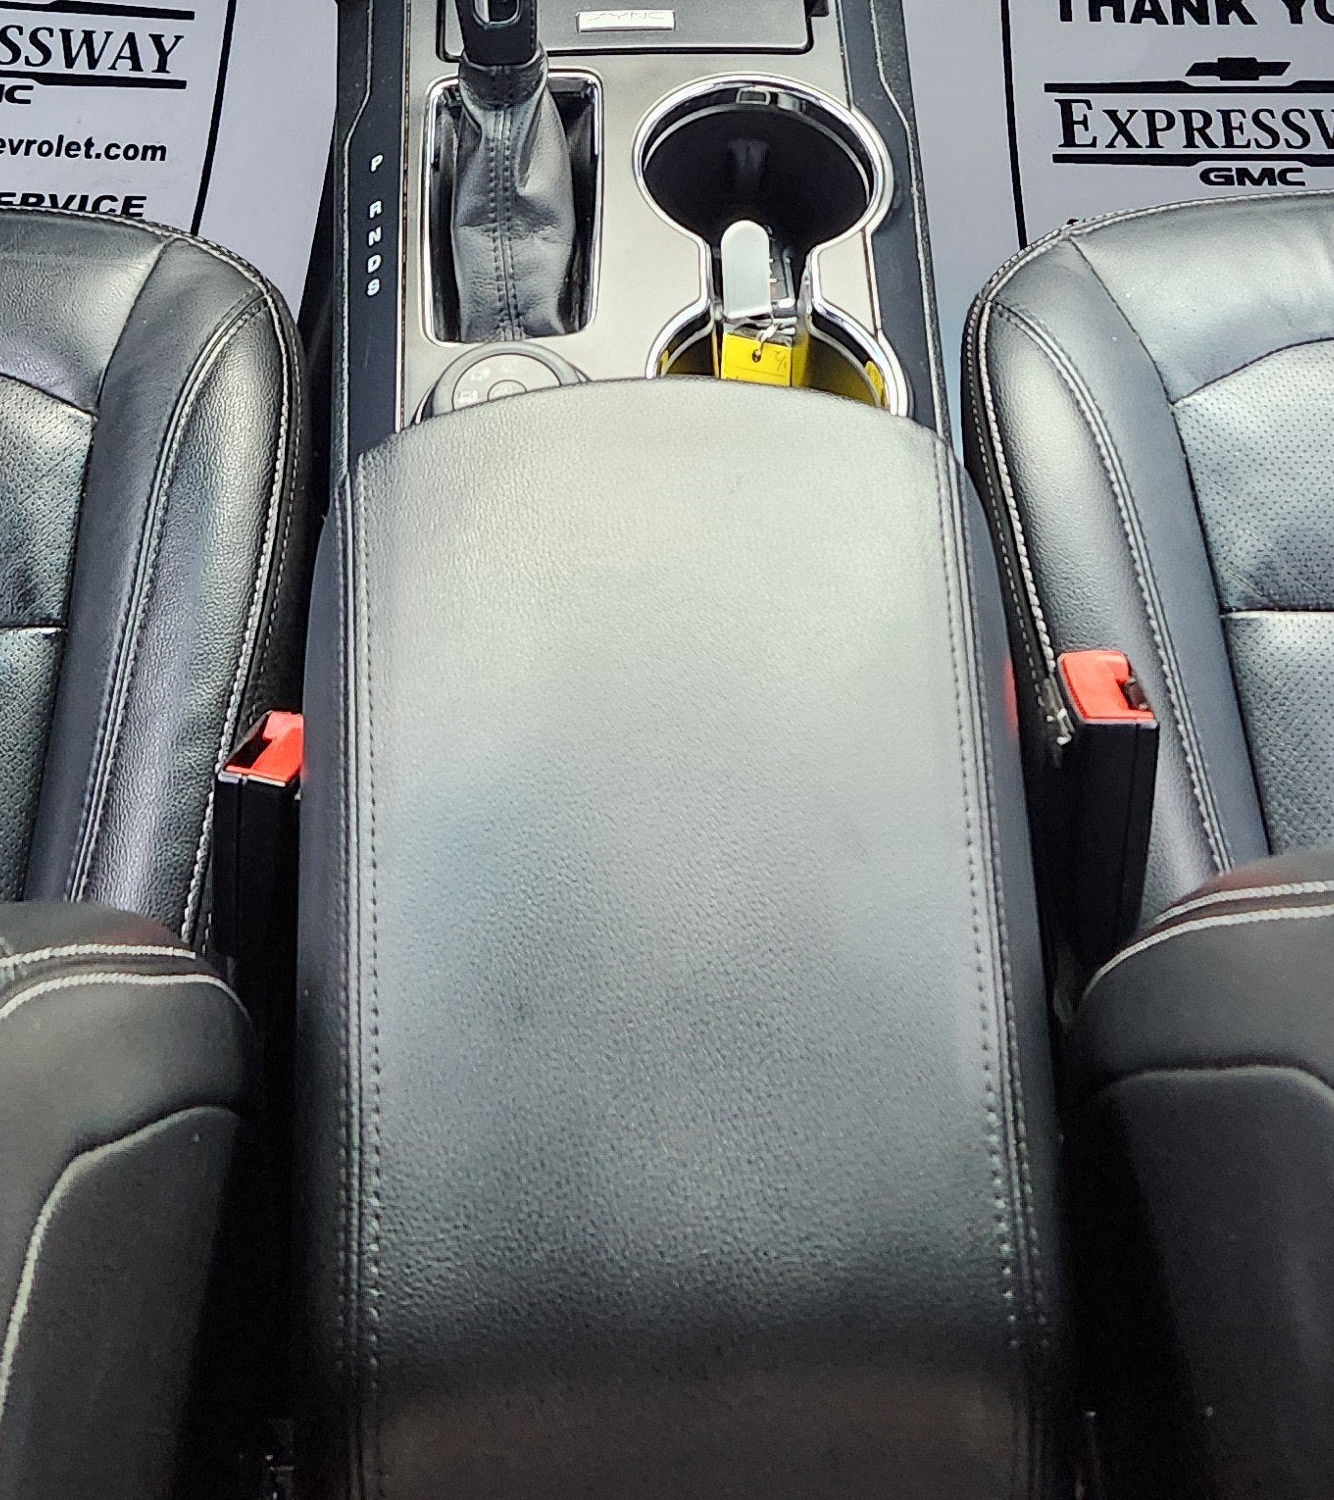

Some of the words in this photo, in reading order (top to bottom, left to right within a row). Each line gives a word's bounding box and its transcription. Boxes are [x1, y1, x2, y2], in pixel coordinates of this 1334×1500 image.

[370, 154, 384, 173] P
[1198, 166, 1307, 188] GMC
[368, 227, 382, 246] N
[367, 254, 382, 274] D
[367, 279, 381, 297] S
